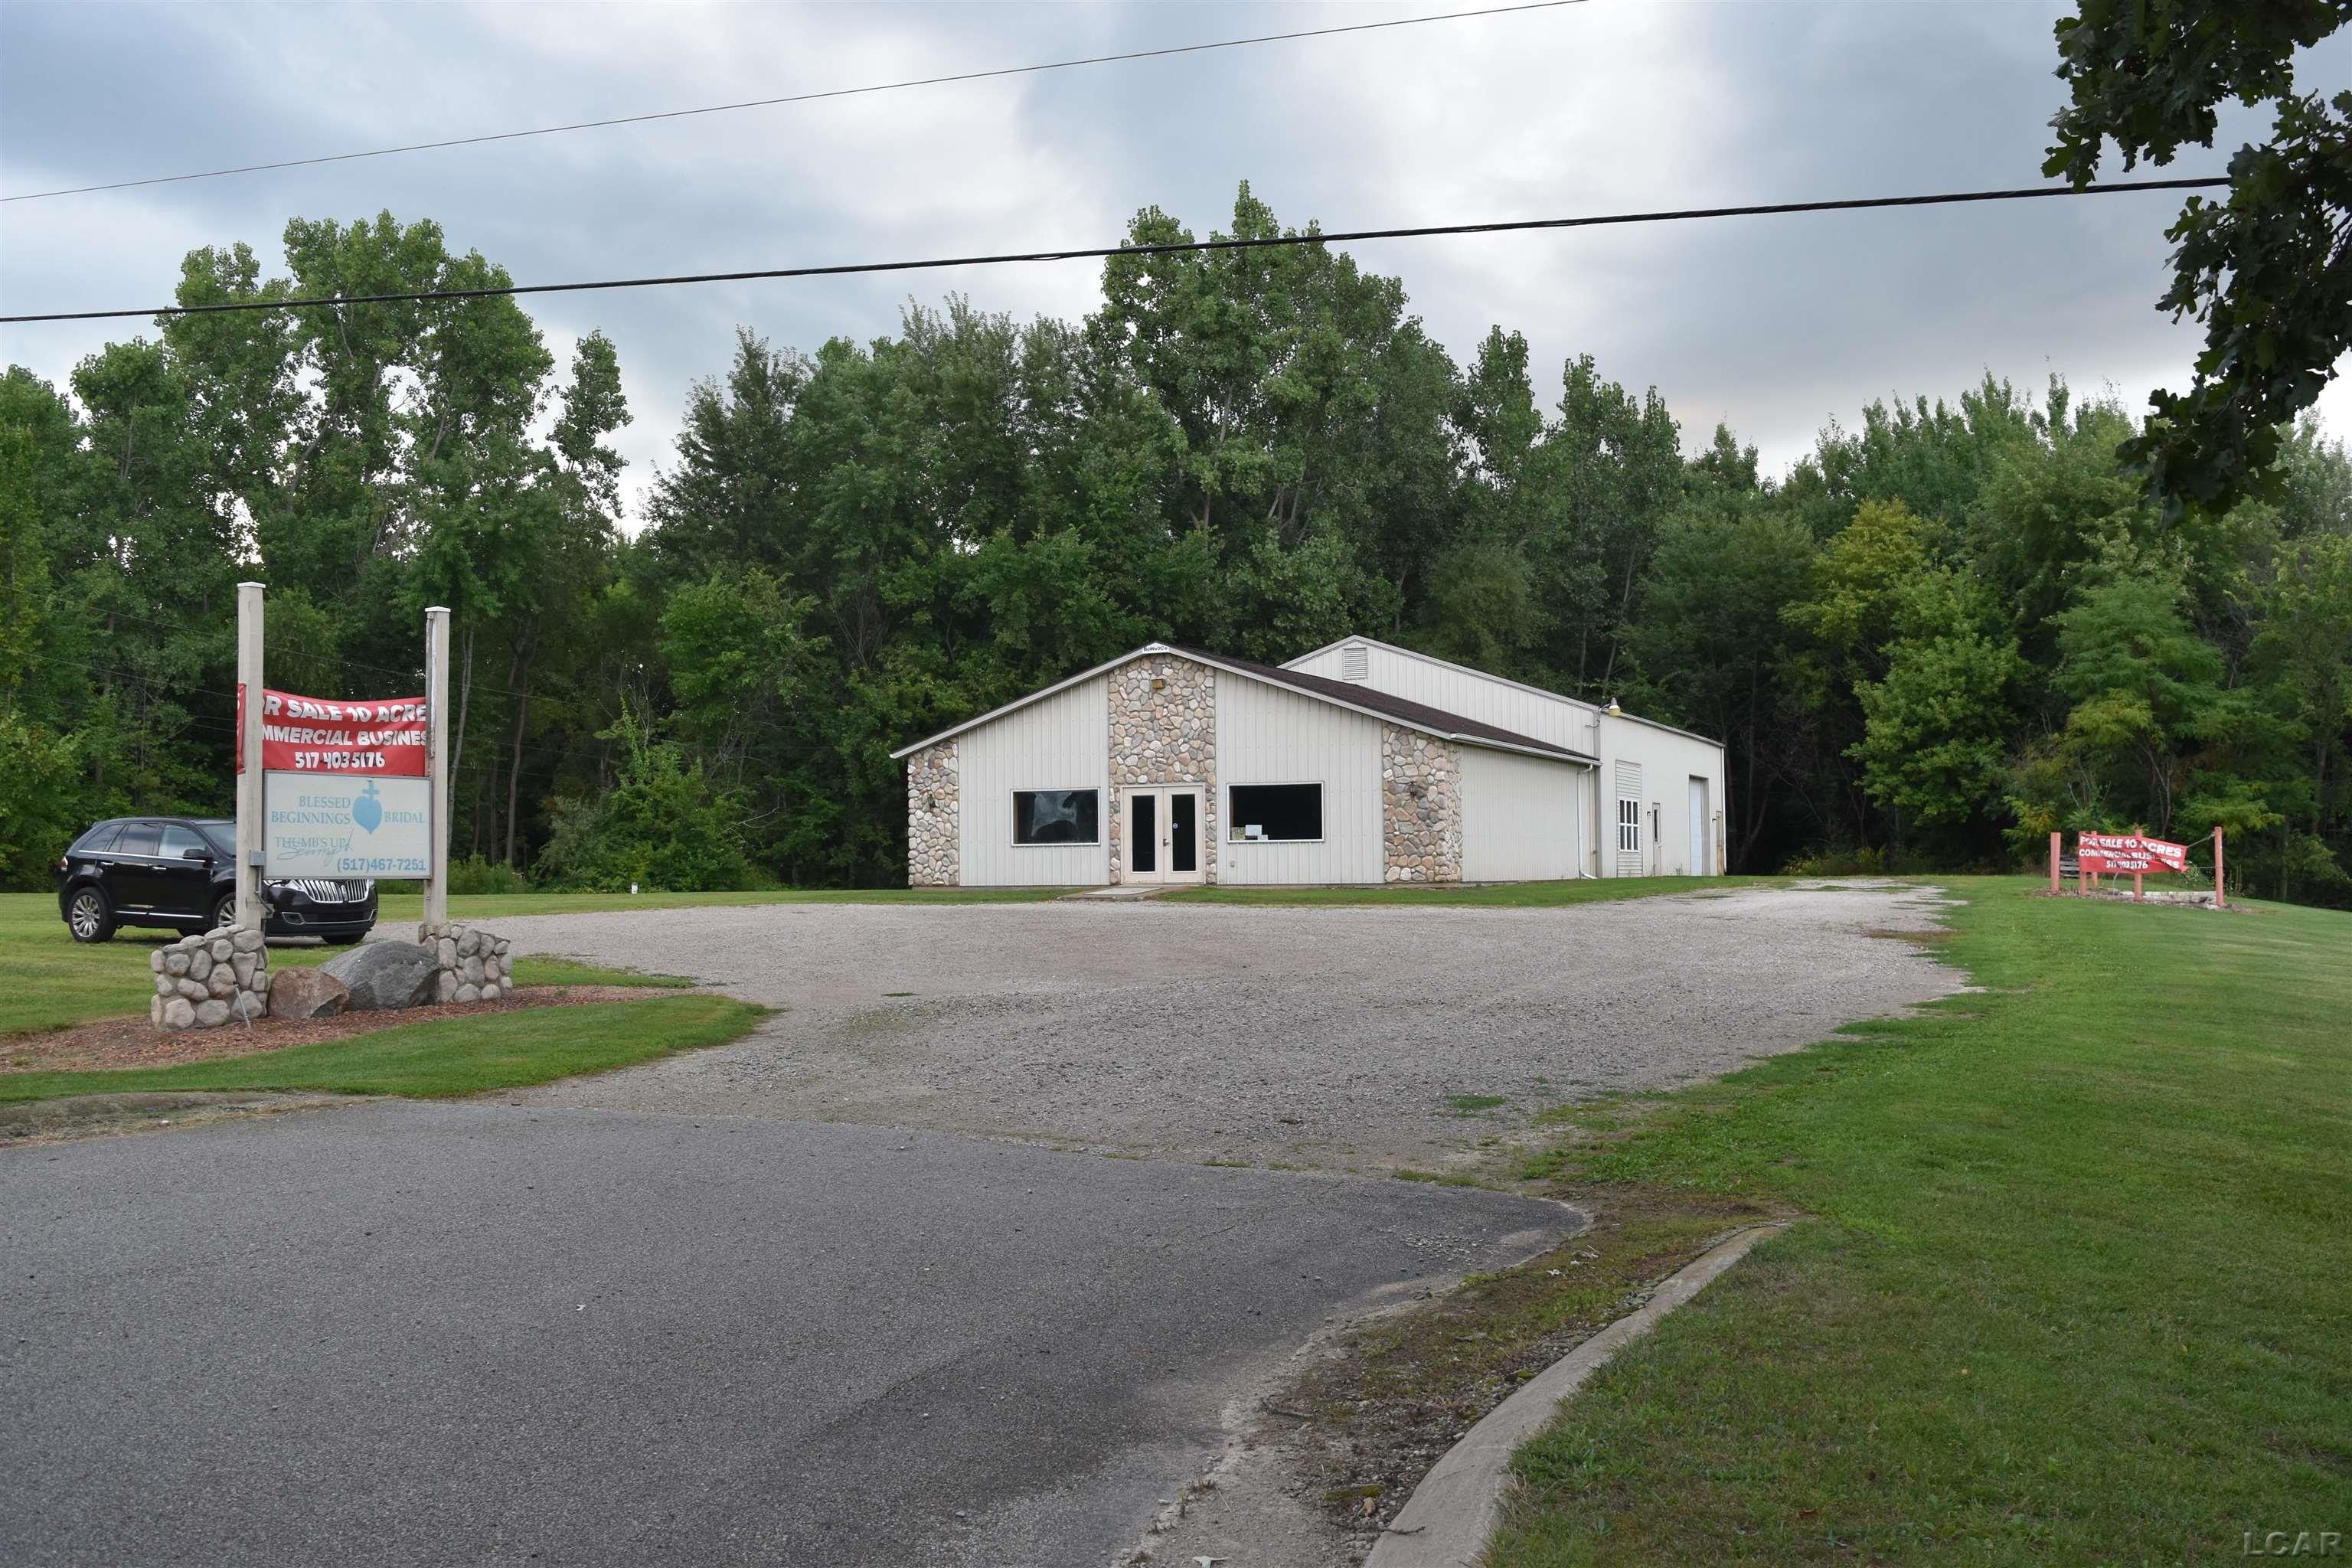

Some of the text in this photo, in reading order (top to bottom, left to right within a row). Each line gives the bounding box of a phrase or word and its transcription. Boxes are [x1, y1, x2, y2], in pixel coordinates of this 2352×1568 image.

[286, 699, 343, 721] SALE
[346, 707, 373, 722] 10
[295, 751, 319, 769] 517
[351, 752, 386, 768] 5176
[299, 795, 351, 808] BLESSED
[271, 811, 425, 825] BEGINNINGS BRIDAL
[2099, 838, 2123, 848] SALE
[2125, 838, 2138, 848] 10
[2139, 840, 2182, 858] ACRES
[337, 858, 426, 873] (517)467-7251
